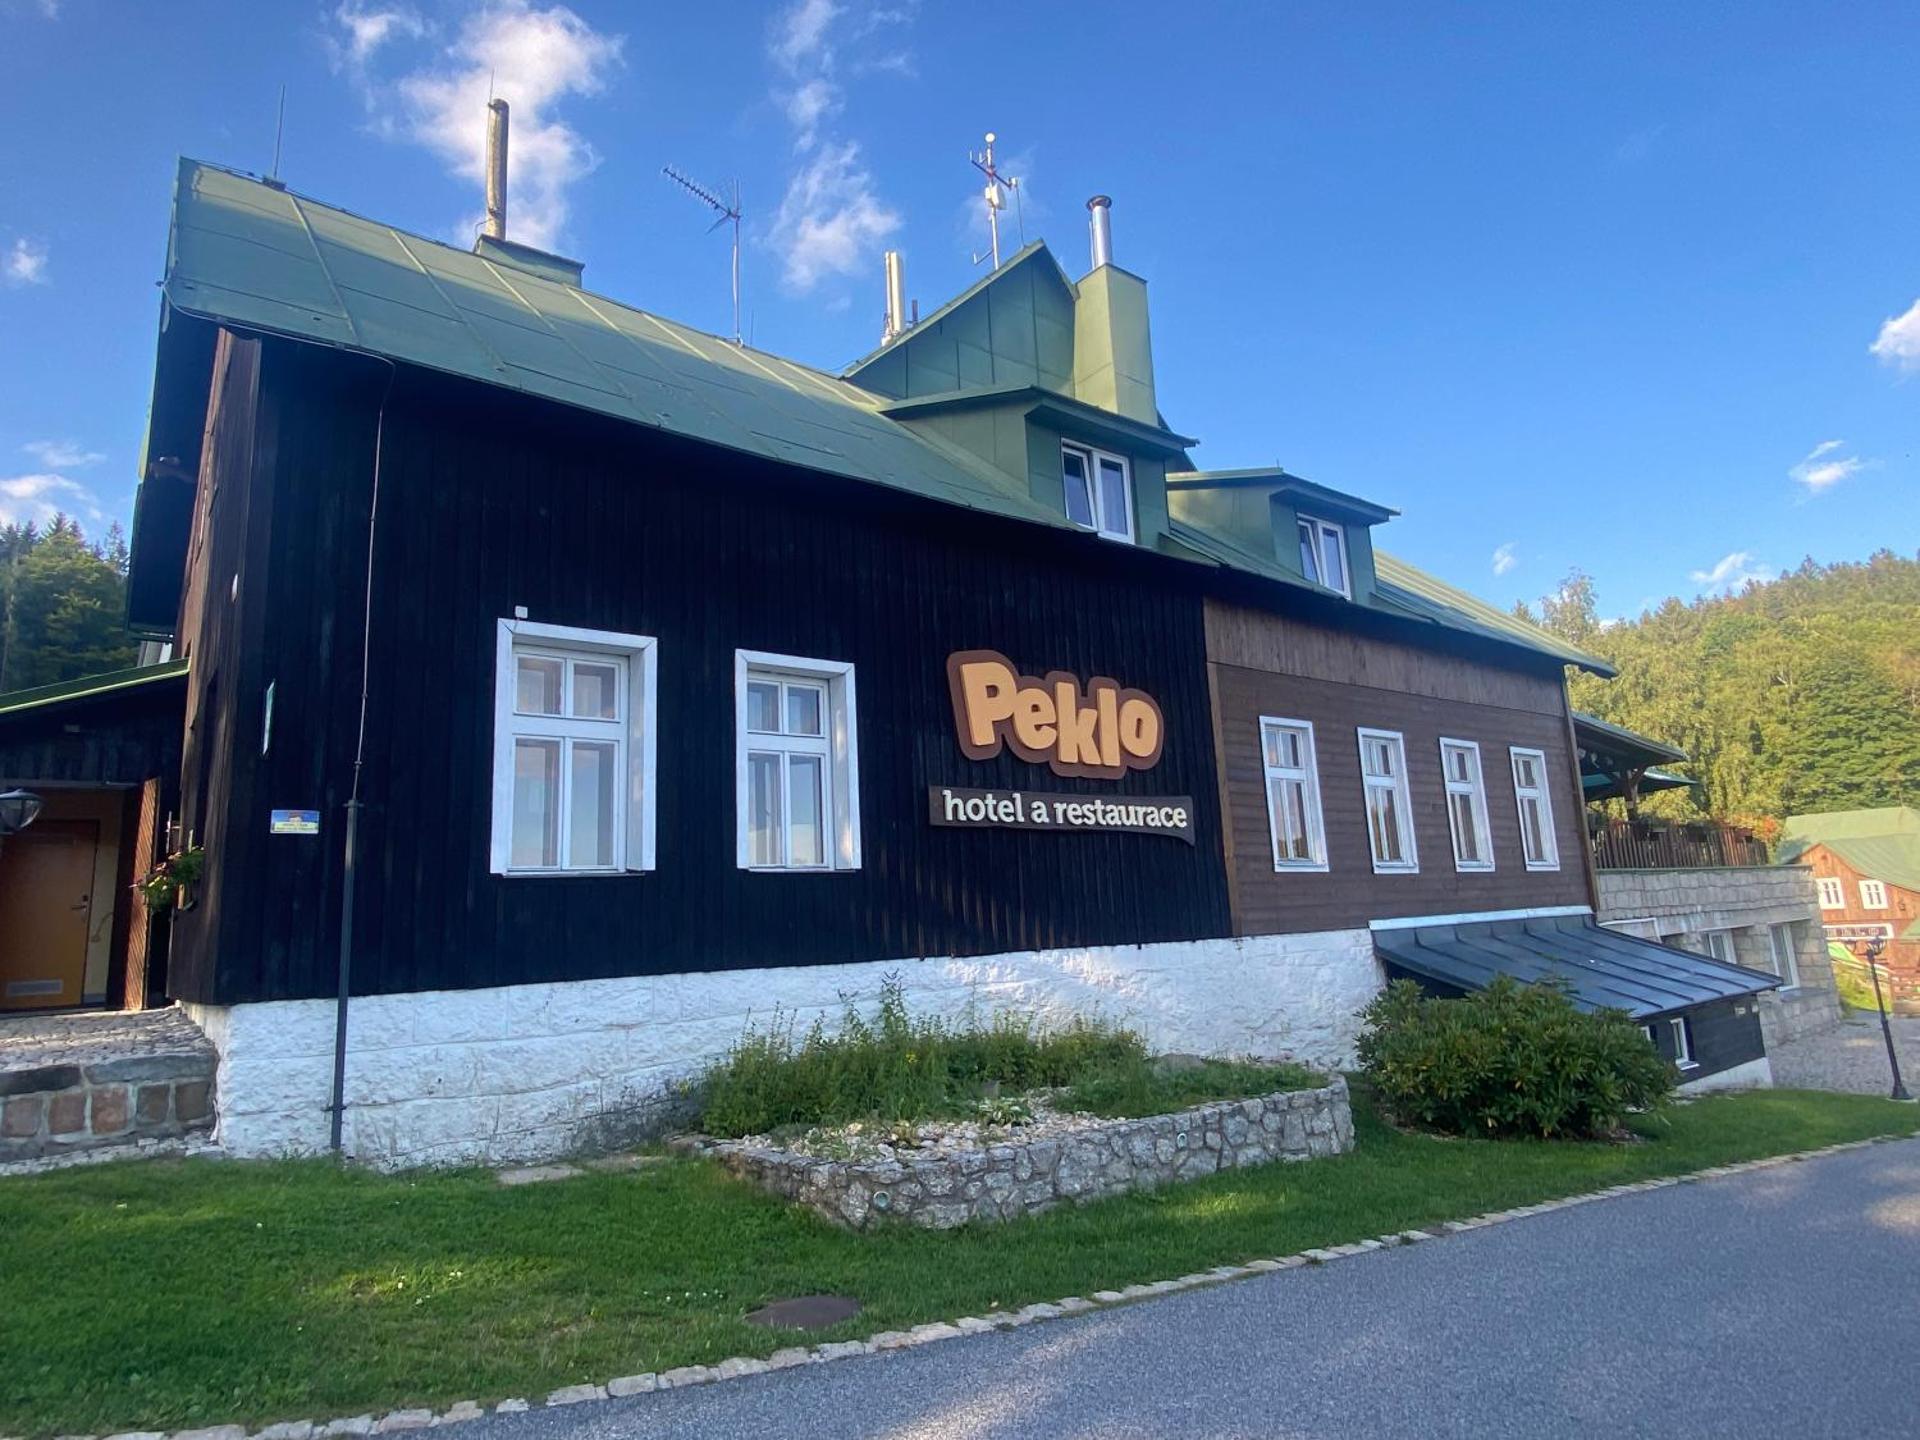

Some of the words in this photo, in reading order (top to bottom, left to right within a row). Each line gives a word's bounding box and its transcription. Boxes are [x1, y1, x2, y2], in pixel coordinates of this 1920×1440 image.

[960, 661, 1158, 767] Peklo
[942, 789, 1024, 822] hotel
[1030, 800, 1050, 823] a
[1053, 799, 1187, 829] restaurace
